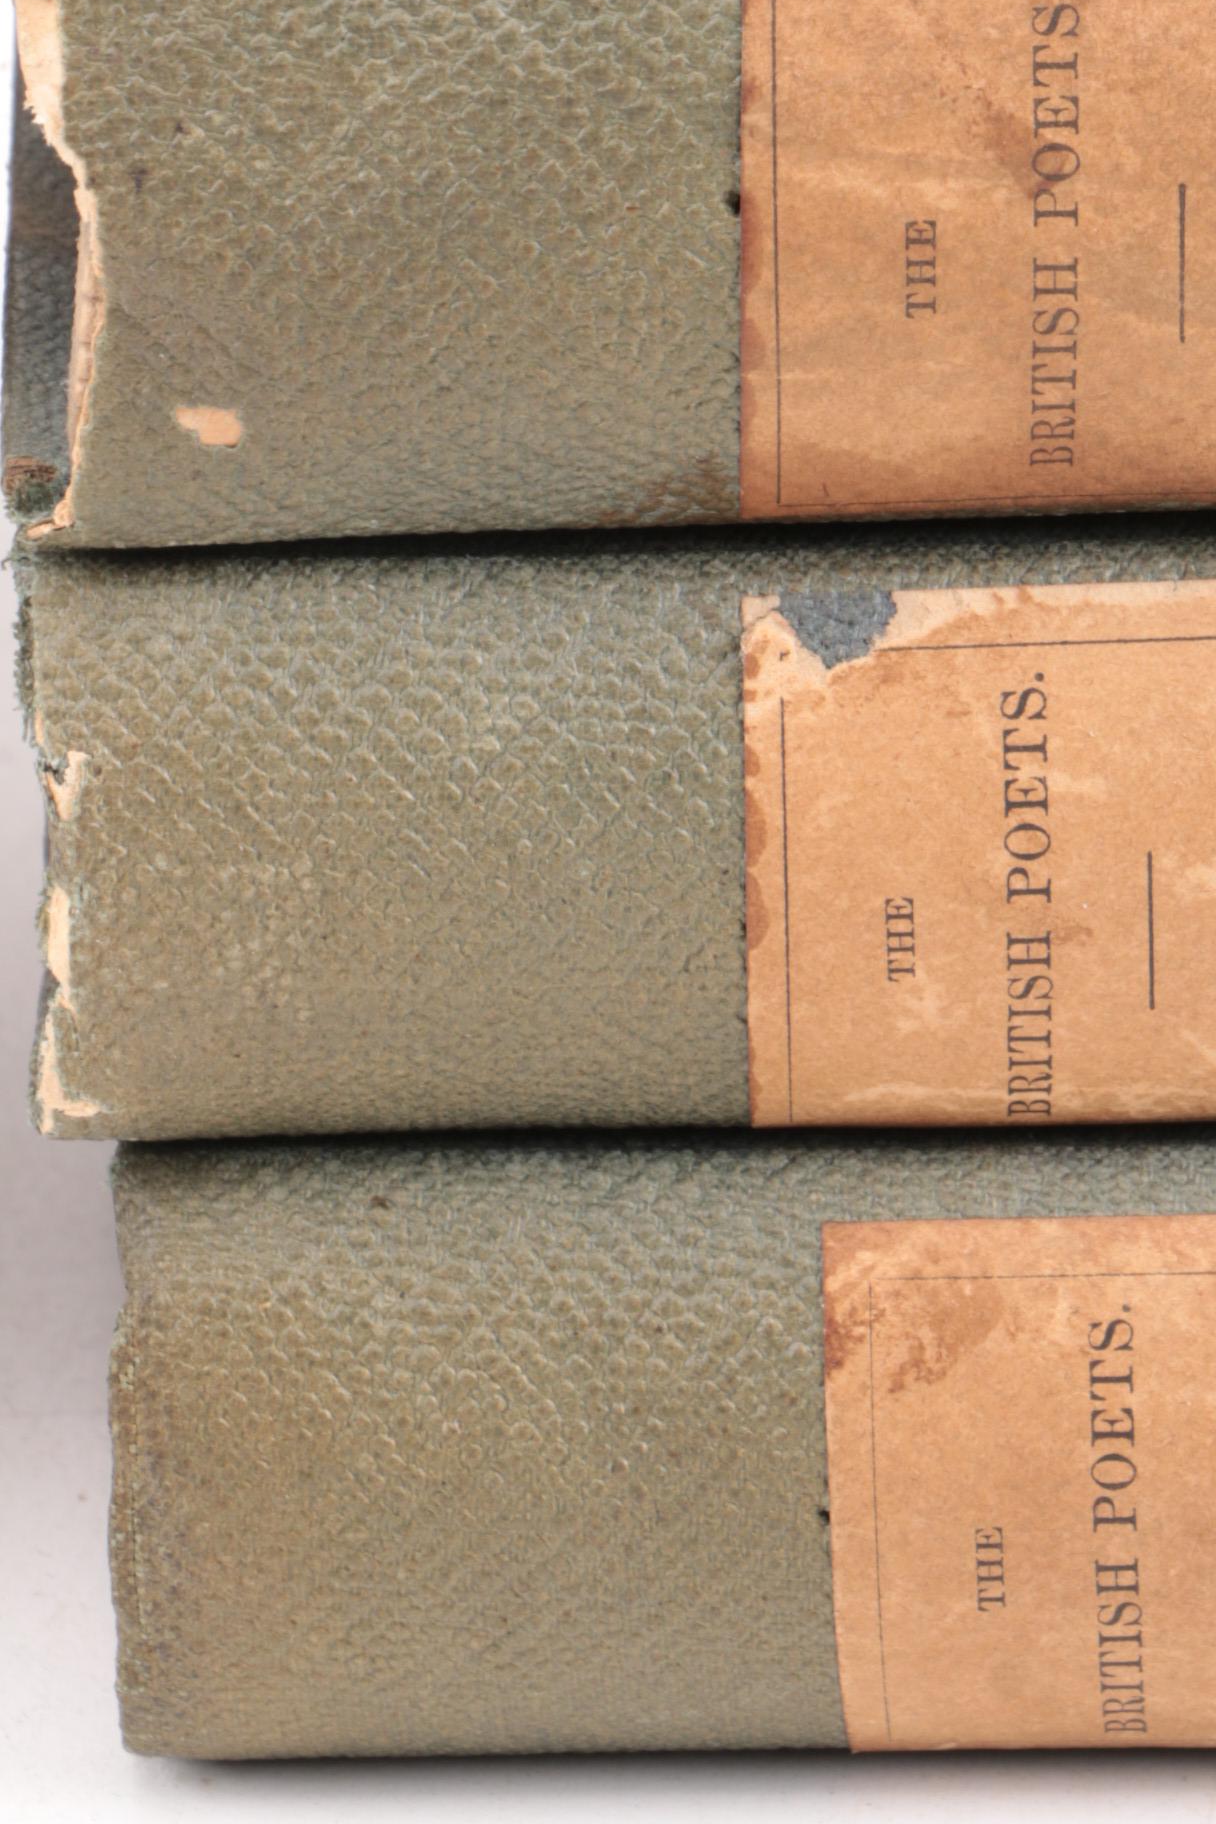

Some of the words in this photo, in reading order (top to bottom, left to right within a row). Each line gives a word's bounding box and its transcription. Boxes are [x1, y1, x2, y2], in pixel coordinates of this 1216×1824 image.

[904, 219, 939, 318] THE
[1030, 256, 1078, 467] BRITISH
[1001, 670, 1051, 904] POETS.
[884, 896, 916, 982] THE
[1003, 929, 1053, 1117] BRITISH
[1089, 1302, 1137, 1532] POETS.
[975, 1525, 1007, 1612] THE
[1093, 1559, 1147, 1734] BRITISH
